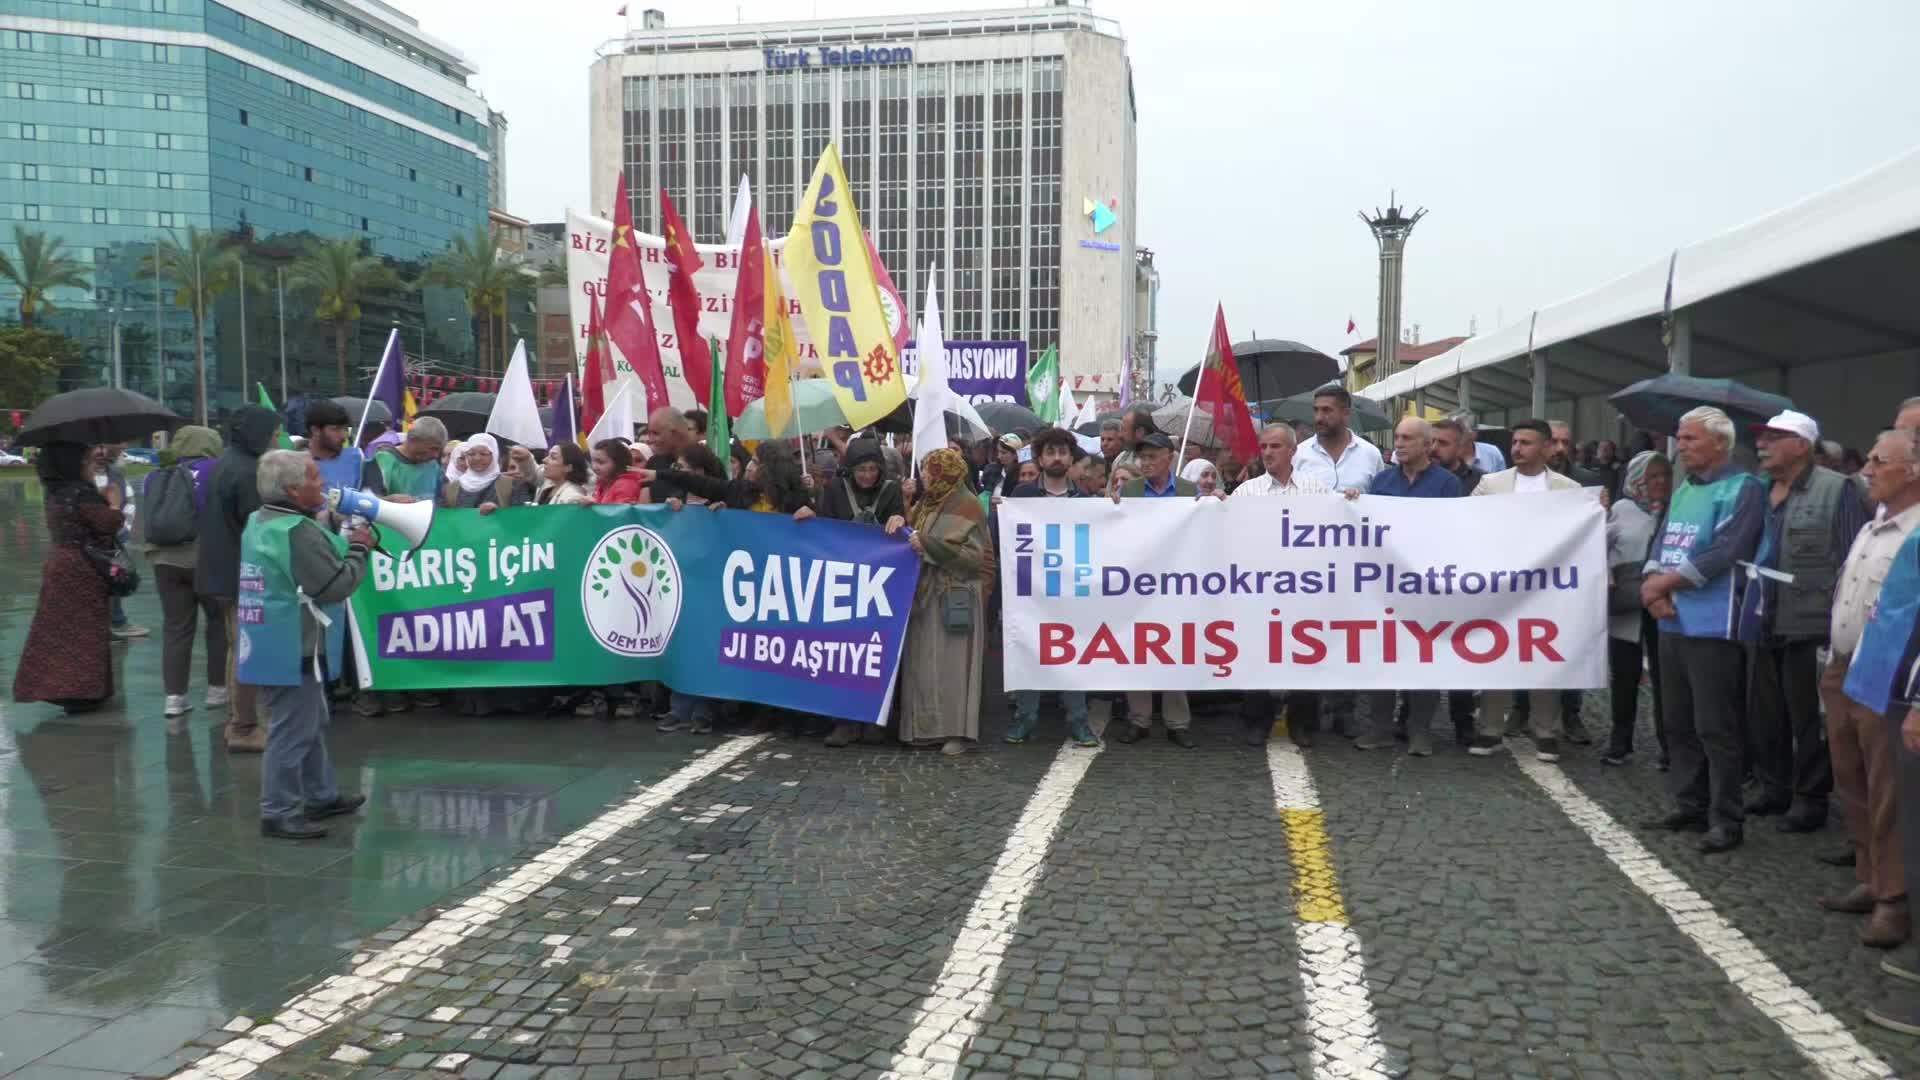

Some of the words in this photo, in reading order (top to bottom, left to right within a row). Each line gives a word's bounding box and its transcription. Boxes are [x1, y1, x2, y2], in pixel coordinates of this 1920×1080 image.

[763, 47, 810, 69] Türk
[818, 44, 914, 65] Telekom
[1281, 509, 1390, 548] İzmir
[372, 547, 477, 593] BARIŞ
[488, 537, 555, 586] İÇİN
[722, 549, 896, 623] GAVEK
[1101, 563, 1336, 597] Demokrasi
[1354, 562, 1579, 597] Platformu
[386, 608, 487, 653] ADIM
[501, 600, 546, 647] AT
[607, 630, 637, 649] DEM
[1039, 621, 1239, 677] BARIŞ
[1268, 606, 1566, 665] İSTİYOR
[724, 632, 746, 659] JI
[754, 635, 786, 664] BO
[791, 631, 883, 678] AŞTIYÊ
